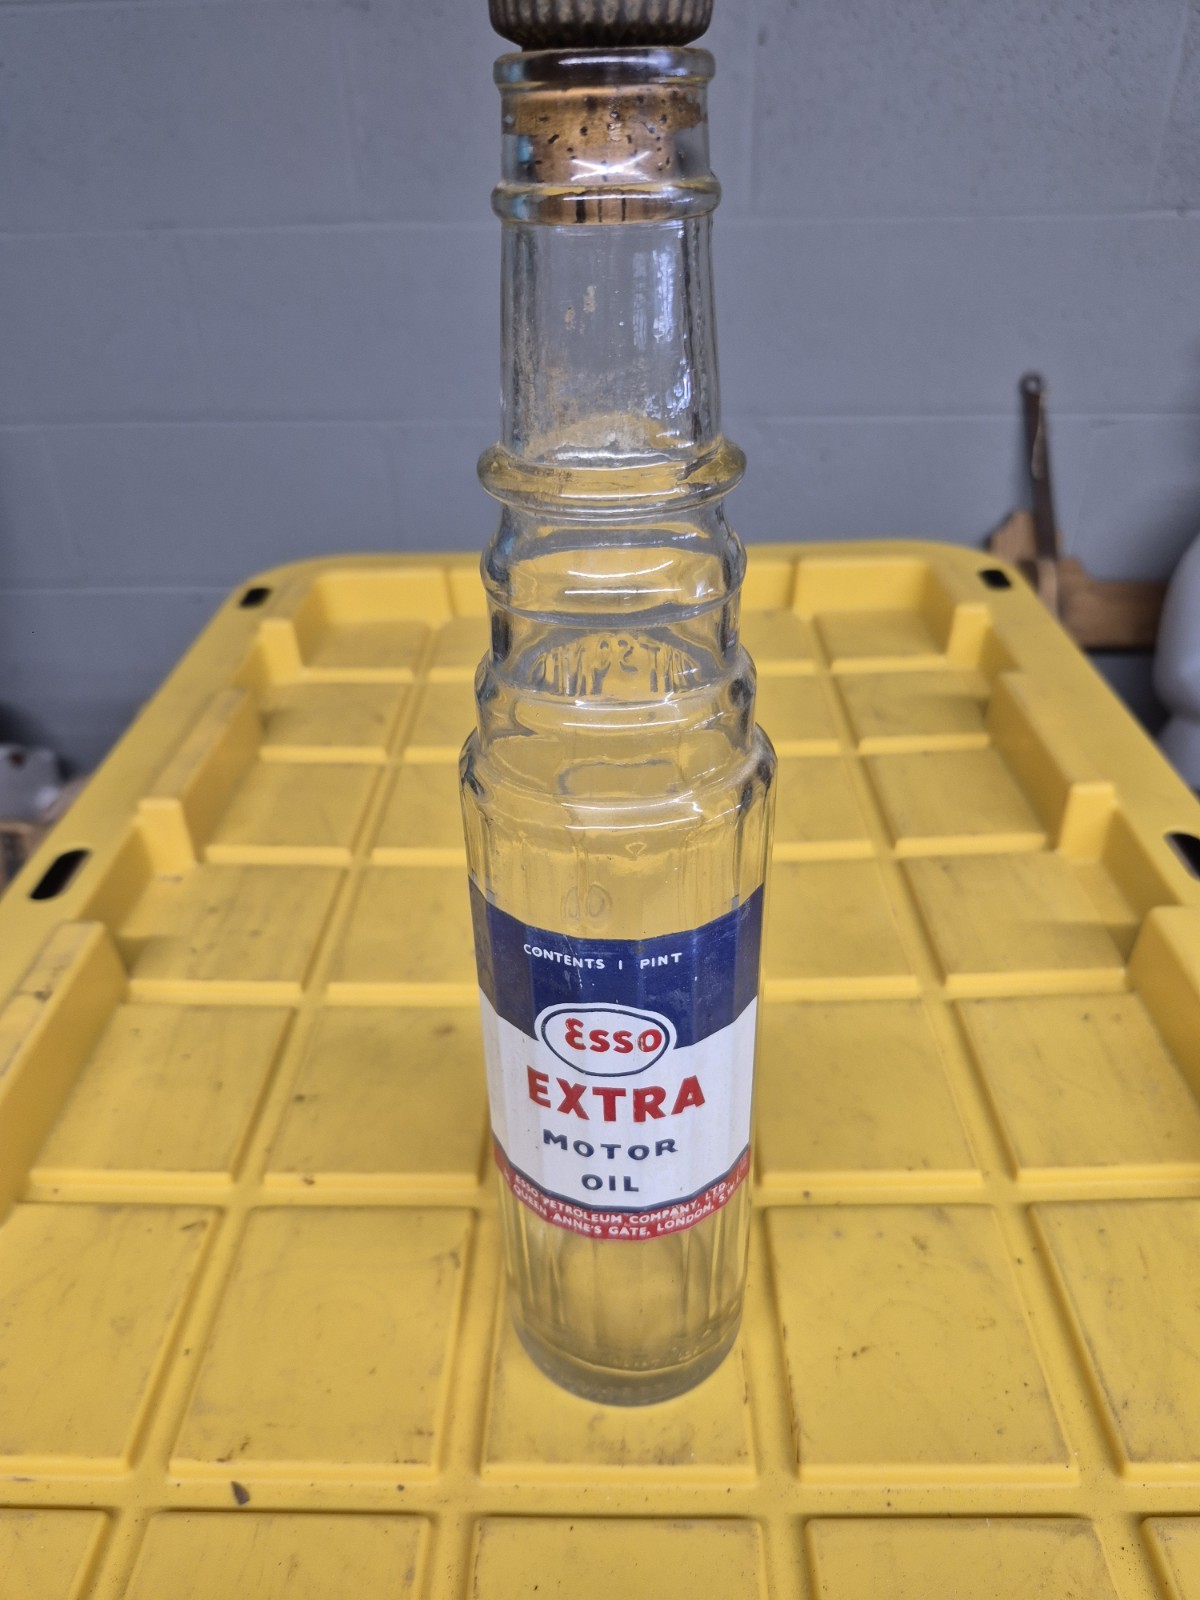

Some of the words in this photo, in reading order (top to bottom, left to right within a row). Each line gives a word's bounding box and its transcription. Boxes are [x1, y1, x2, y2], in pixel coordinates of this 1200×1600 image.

[523, 943, 606, 970] CONTENTS
[639, 952, 683, 970] PINT
[526, 1065, 706, 1123] EXTRA
[543, 1128, 679, 1161] MOTOR
[514, 1174, 539, 1198] ESSO
[543, 1196, 623, 1224] PETROLEUM
[581, 1173, 640, 1193] OIL
[513, 1184, 548, 1217] QUEEN
[552, 1212, 602, 1235] ANNE'S
